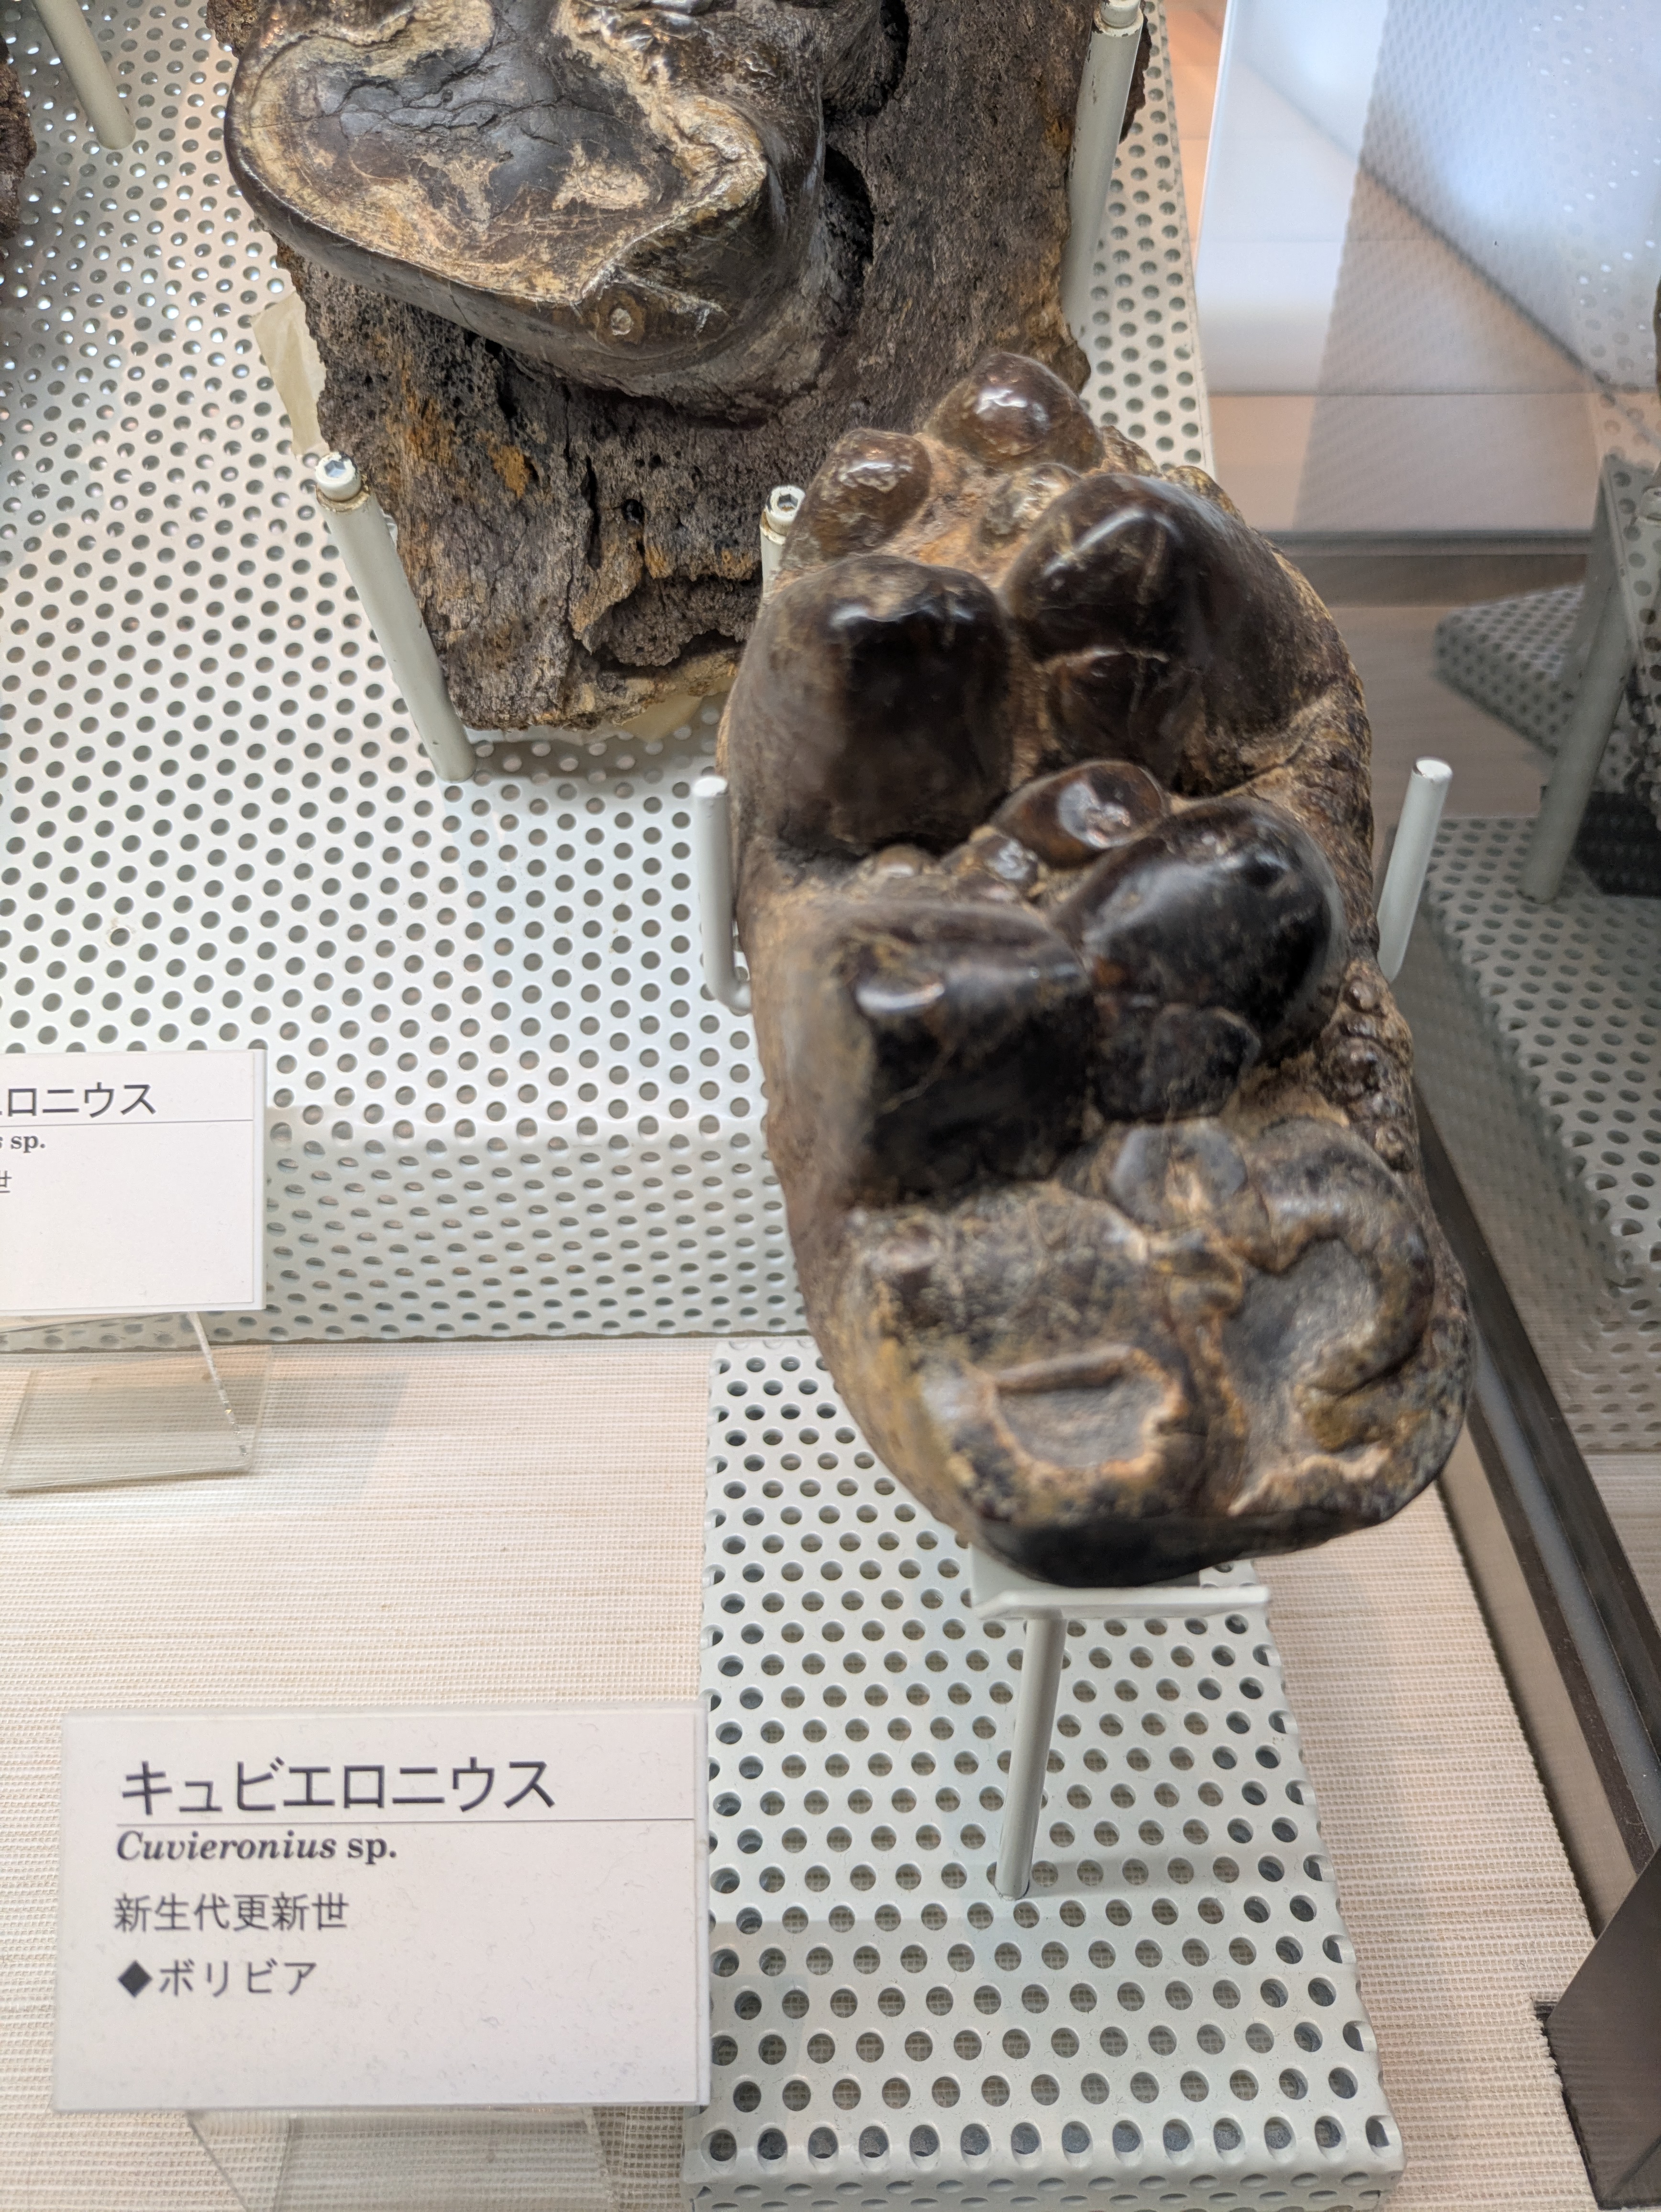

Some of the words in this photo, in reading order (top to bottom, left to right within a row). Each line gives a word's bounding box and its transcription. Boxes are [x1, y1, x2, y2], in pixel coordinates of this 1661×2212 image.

[0, 1082, 156, 1118] ロニウス
[10, 1136, 46, 1153] sp.
[121, 1756, 556, 1816] キュビエロニウス
[116, 1830, 337, 1861] Cuvieronius
[346, 1838, 397, 1866] sp.
[113, 1891, 350, 1933] 新生代更新世
[158, 1958, 318, 1999] ボリビア
